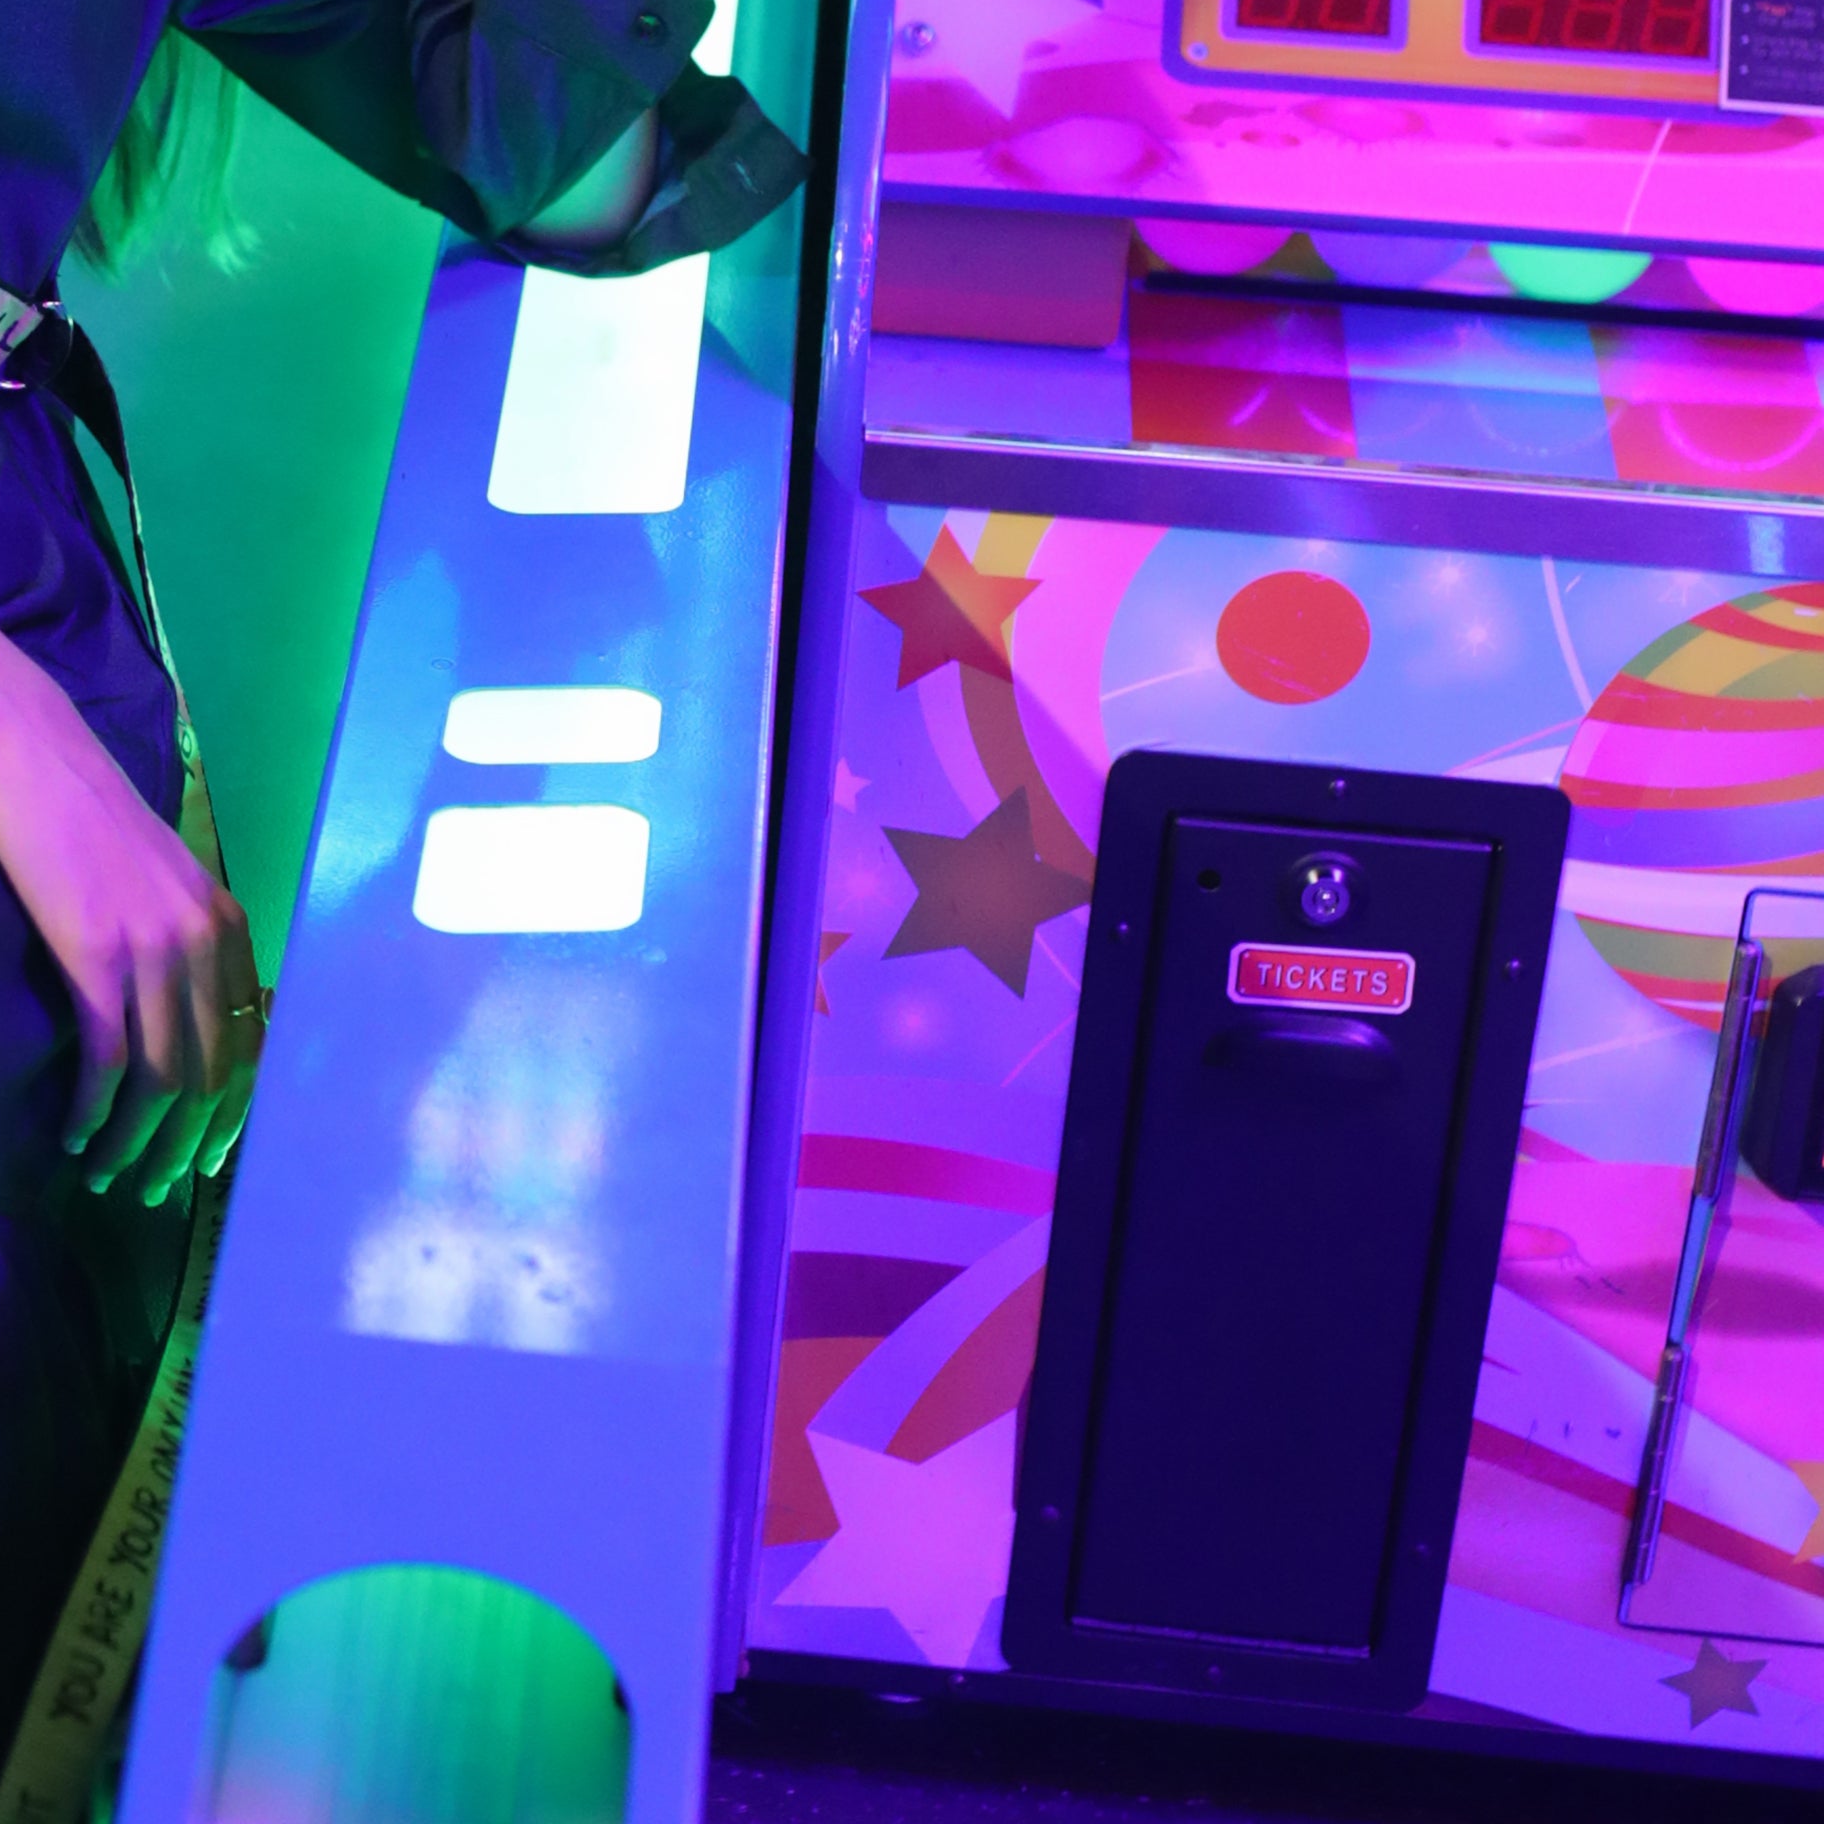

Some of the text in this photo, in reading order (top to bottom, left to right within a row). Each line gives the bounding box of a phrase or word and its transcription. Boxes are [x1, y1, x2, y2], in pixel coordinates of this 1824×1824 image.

[1257, 961, 1389, 996] TICKETS
[49, 1639, 106, 1726] YOU
[81, 1577, 135, 1648] ARE
[108, 1485, 169, 1576] YOUR
